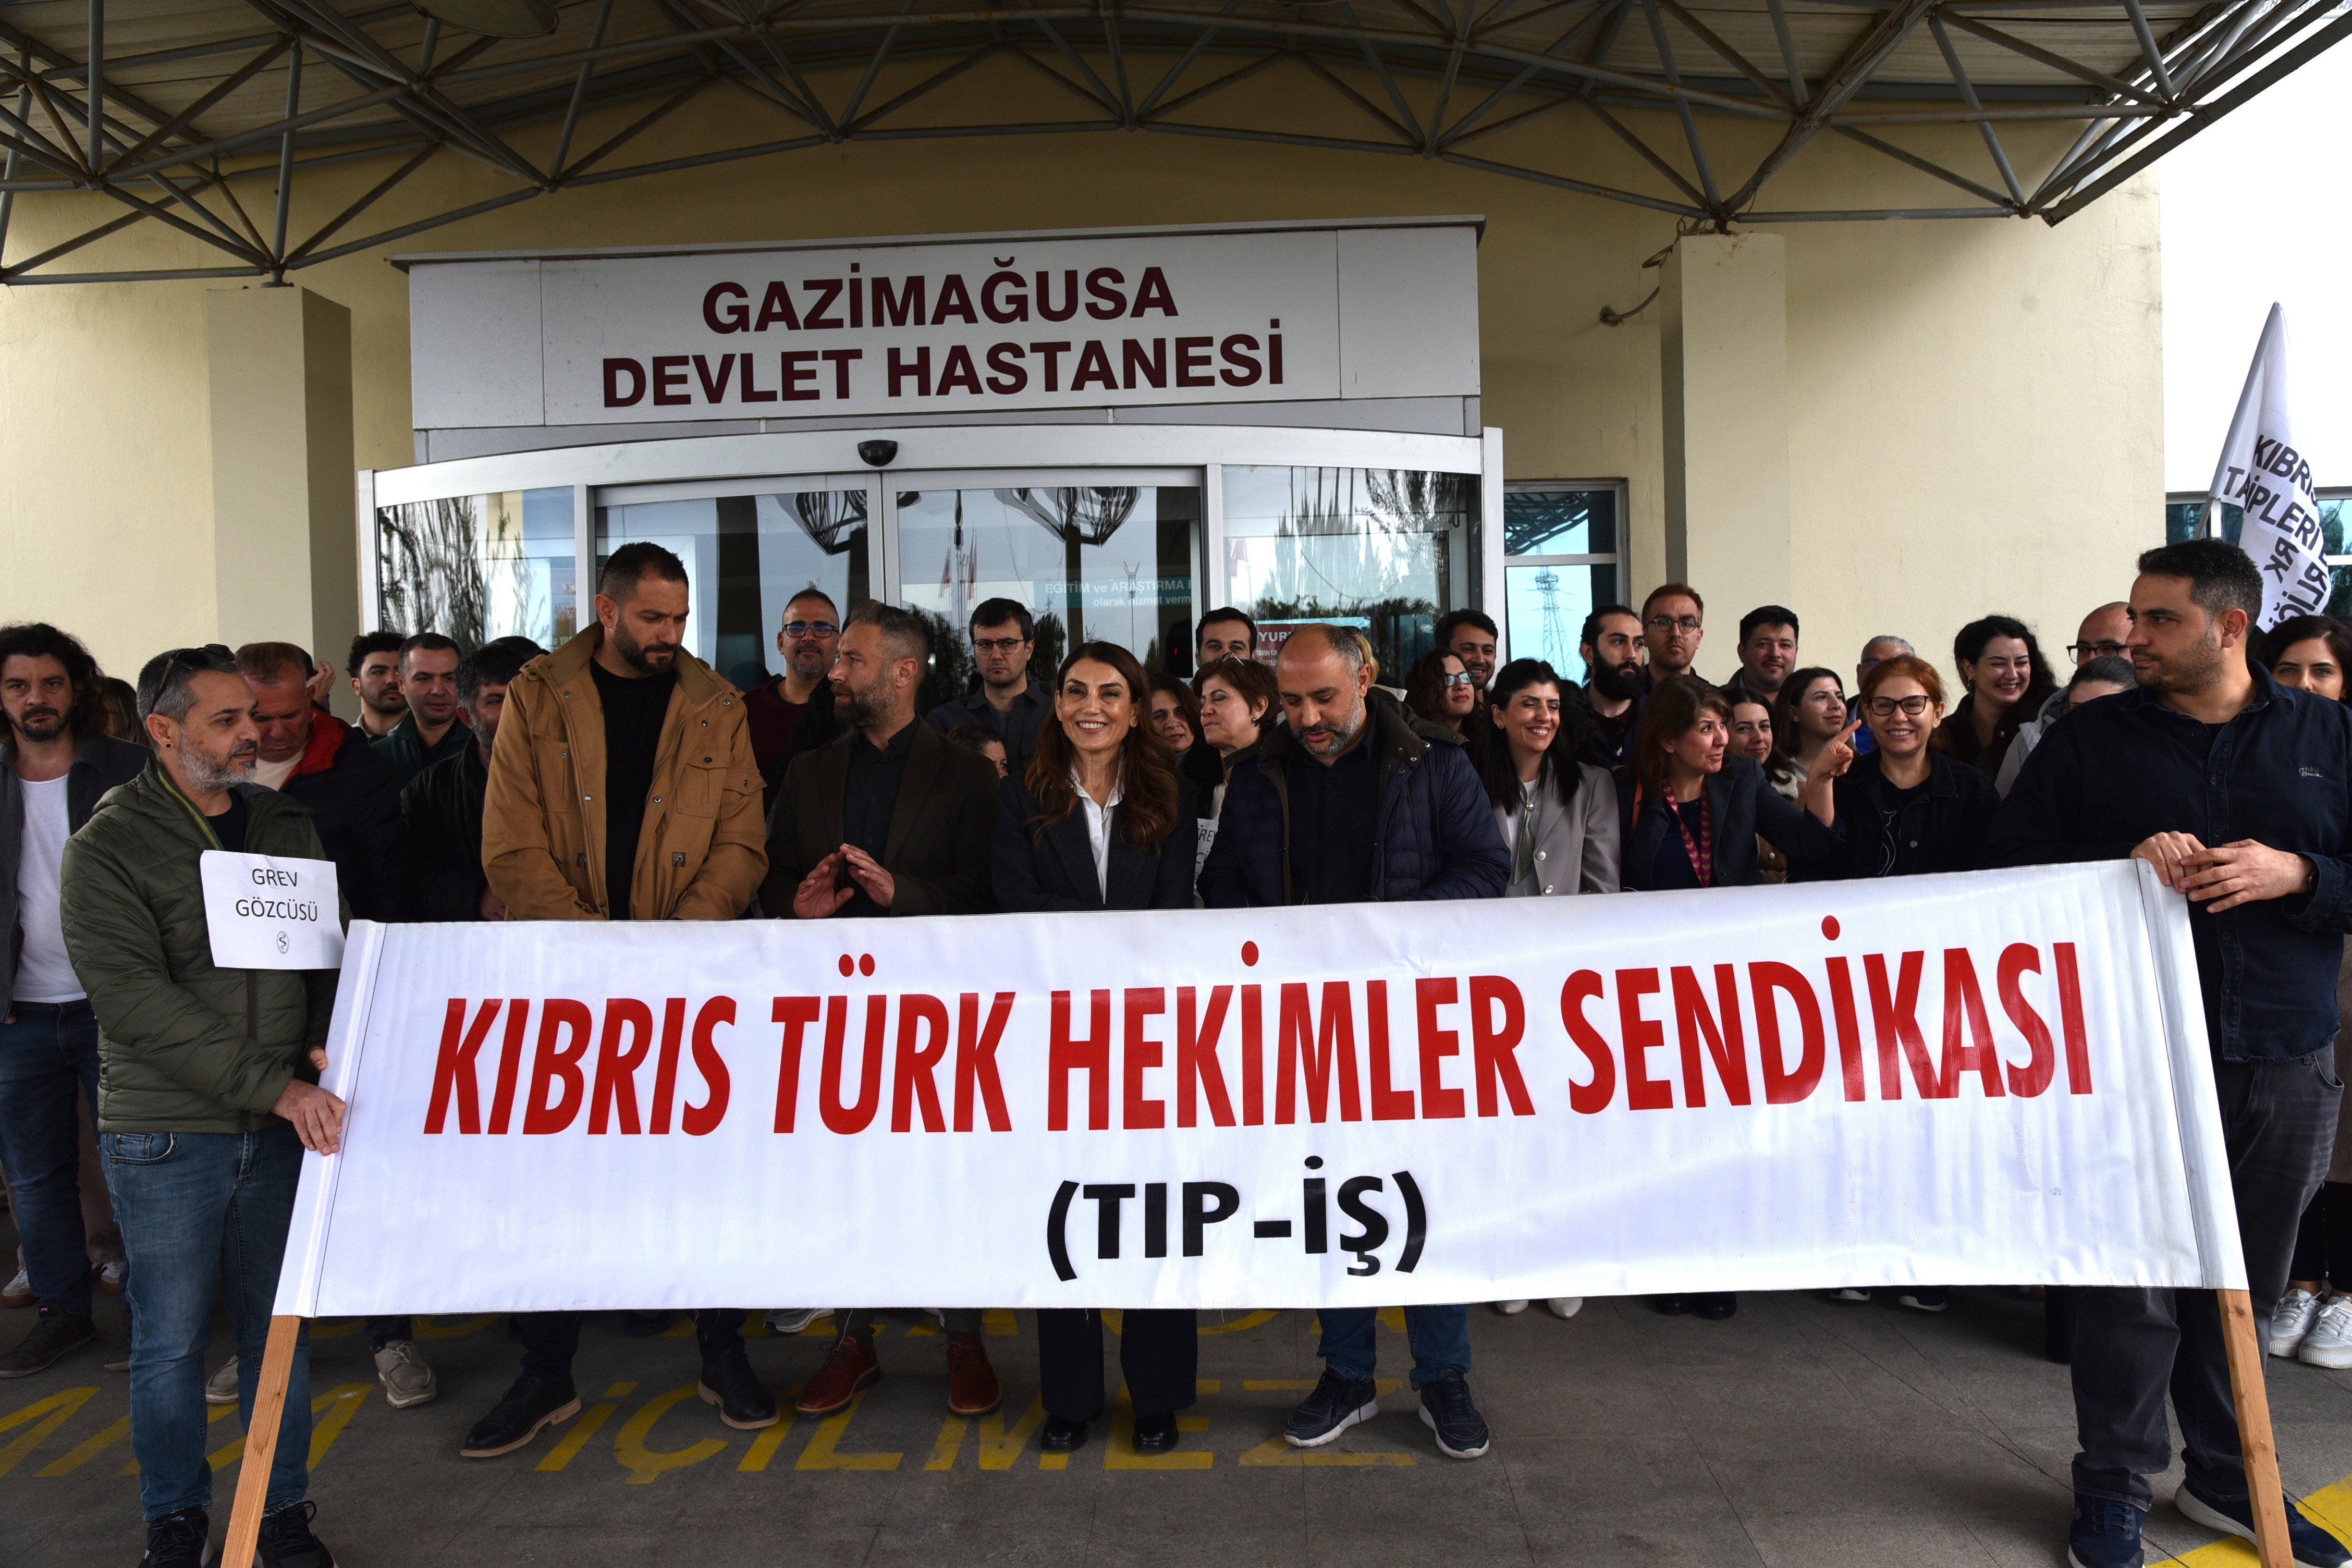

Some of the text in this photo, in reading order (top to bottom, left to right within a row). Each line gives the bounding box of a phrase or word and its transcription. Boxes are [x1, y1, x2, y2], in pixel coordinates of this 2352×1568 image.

[703, 256, 1179, 334] GAZİMAĞUSA
[603, 318, 1283, 408] DEVLET HASTANESİ
[1046, 581, 1090, 593] EĞİTİM
[1093, 584, 1108, 593] ve
[1111, 579, 1184, 594] ARAŞTIRMA
[1093, 597, 1125, 606] olarak
[1165, 595, 1191, 604] verm
[1258, 631, 1292, 642] YUR
[252, 868, 298, 887] GREV
[236, 896, 317, 922] GÖZCÜSÜ
[424, 915, 2093, 1136] KIBRIS TÜRK HEKİMLER SENDİKASI
